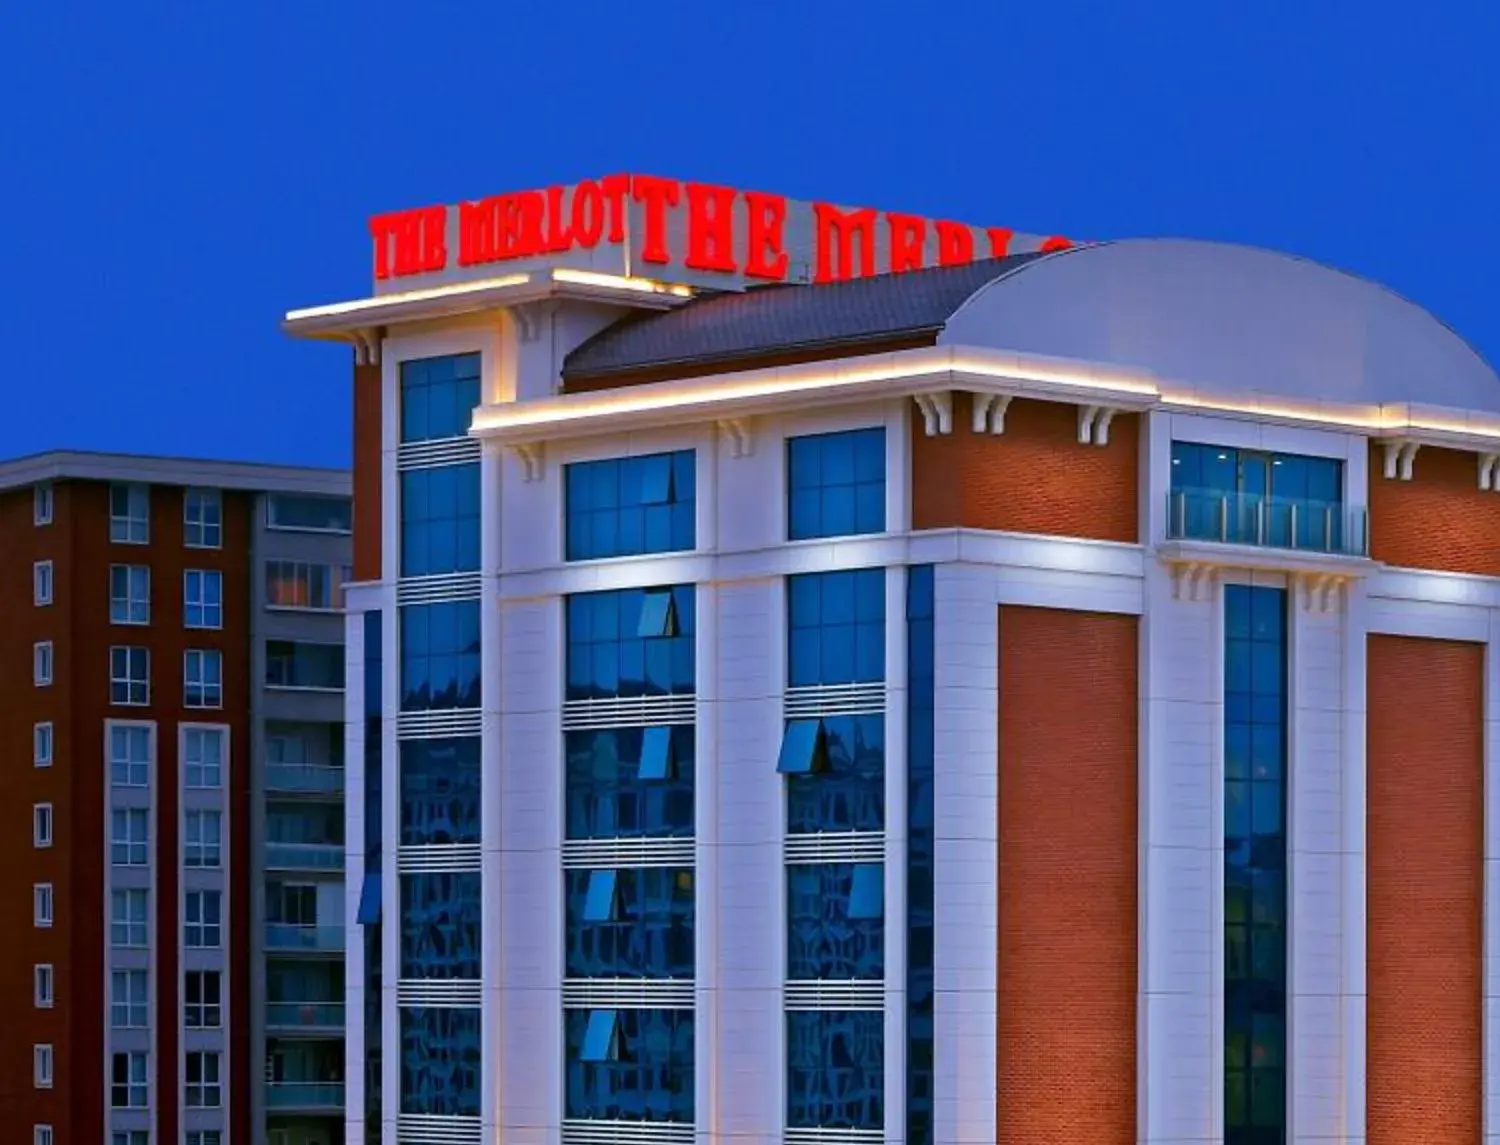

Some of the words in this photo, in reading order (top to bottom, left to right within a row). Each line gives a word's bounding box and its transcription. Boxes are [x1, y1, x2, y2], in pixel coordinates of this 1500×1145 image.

[369, 204, 447, 280] THE
[456, 172, 631, 267] MERLOT
[633, 173, 788, 281] THE
